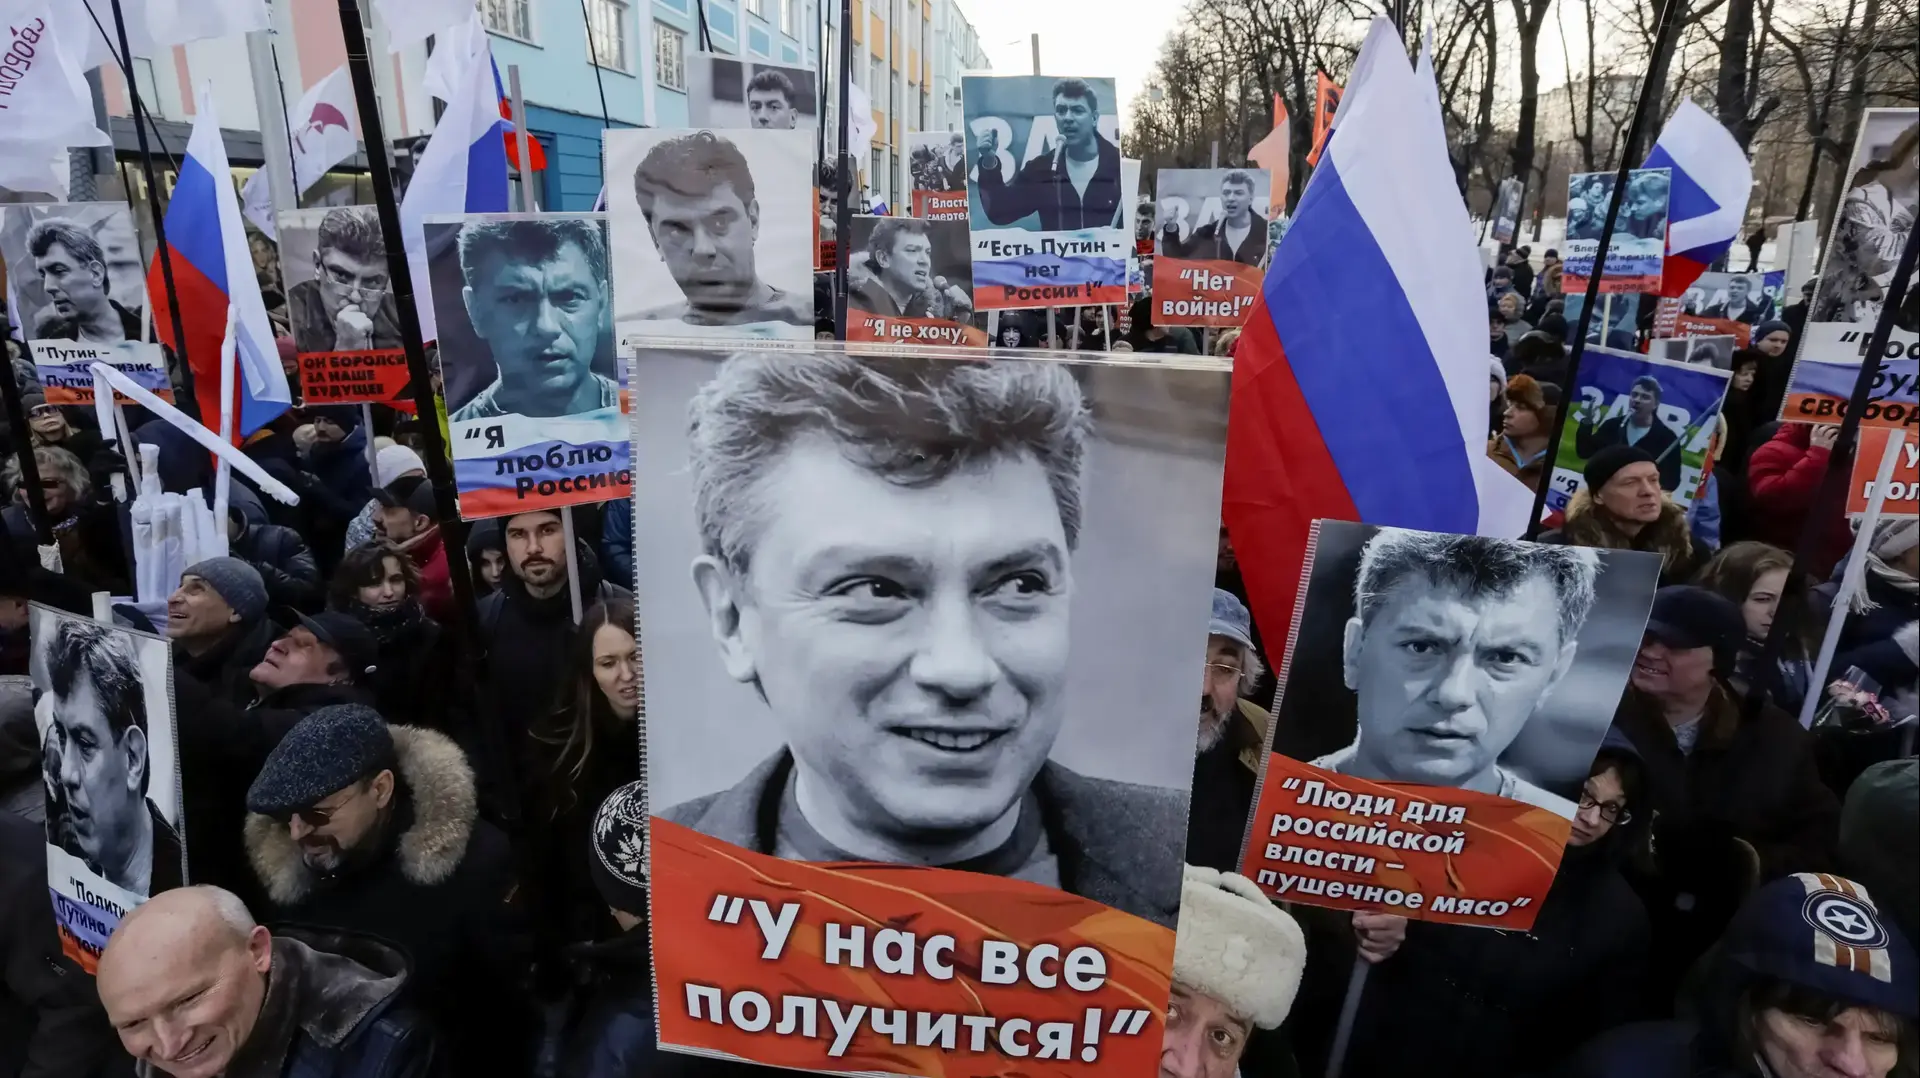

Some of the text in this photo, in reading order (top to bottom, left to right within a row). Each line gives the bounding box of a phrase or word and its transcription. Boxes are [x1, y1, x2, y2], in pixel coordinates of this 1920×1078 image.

[0, 17, 45, 109] СВОБОД
[977, 239, 1034, 257] “Есть
[1041, 238, 1106, 258] Путин
[1024, 264, 1061, 278] нет
[1179, 269, 1235, 291] “Нет
[1004, 285, 1079, 301] России
[863, 318, 968, 345] “Я не хочу,
[36, 346, 98, 361] “Путин
[303, 357, 327, 369] ОН
[328, 369, 376, 382] НАШЕ
[464, 425, 506, 449] “Я
[495, 444, 613, 476] люблю
[515, 469, 630, 500] Россию
[1281, 777, 1466, 825] “Люди для
[1270, 812, 1466, 855] российской
[1264, 842, 1376, 874] власти
[70, 876, 128, 920] “Полити
[1257, 868, 1532, 917] пушечное мясо”
[56, 894, 107, 937] Путина
[707, 894, 1107, 992] “У нас все
[684, 982, 1151, 1063] получится!”
